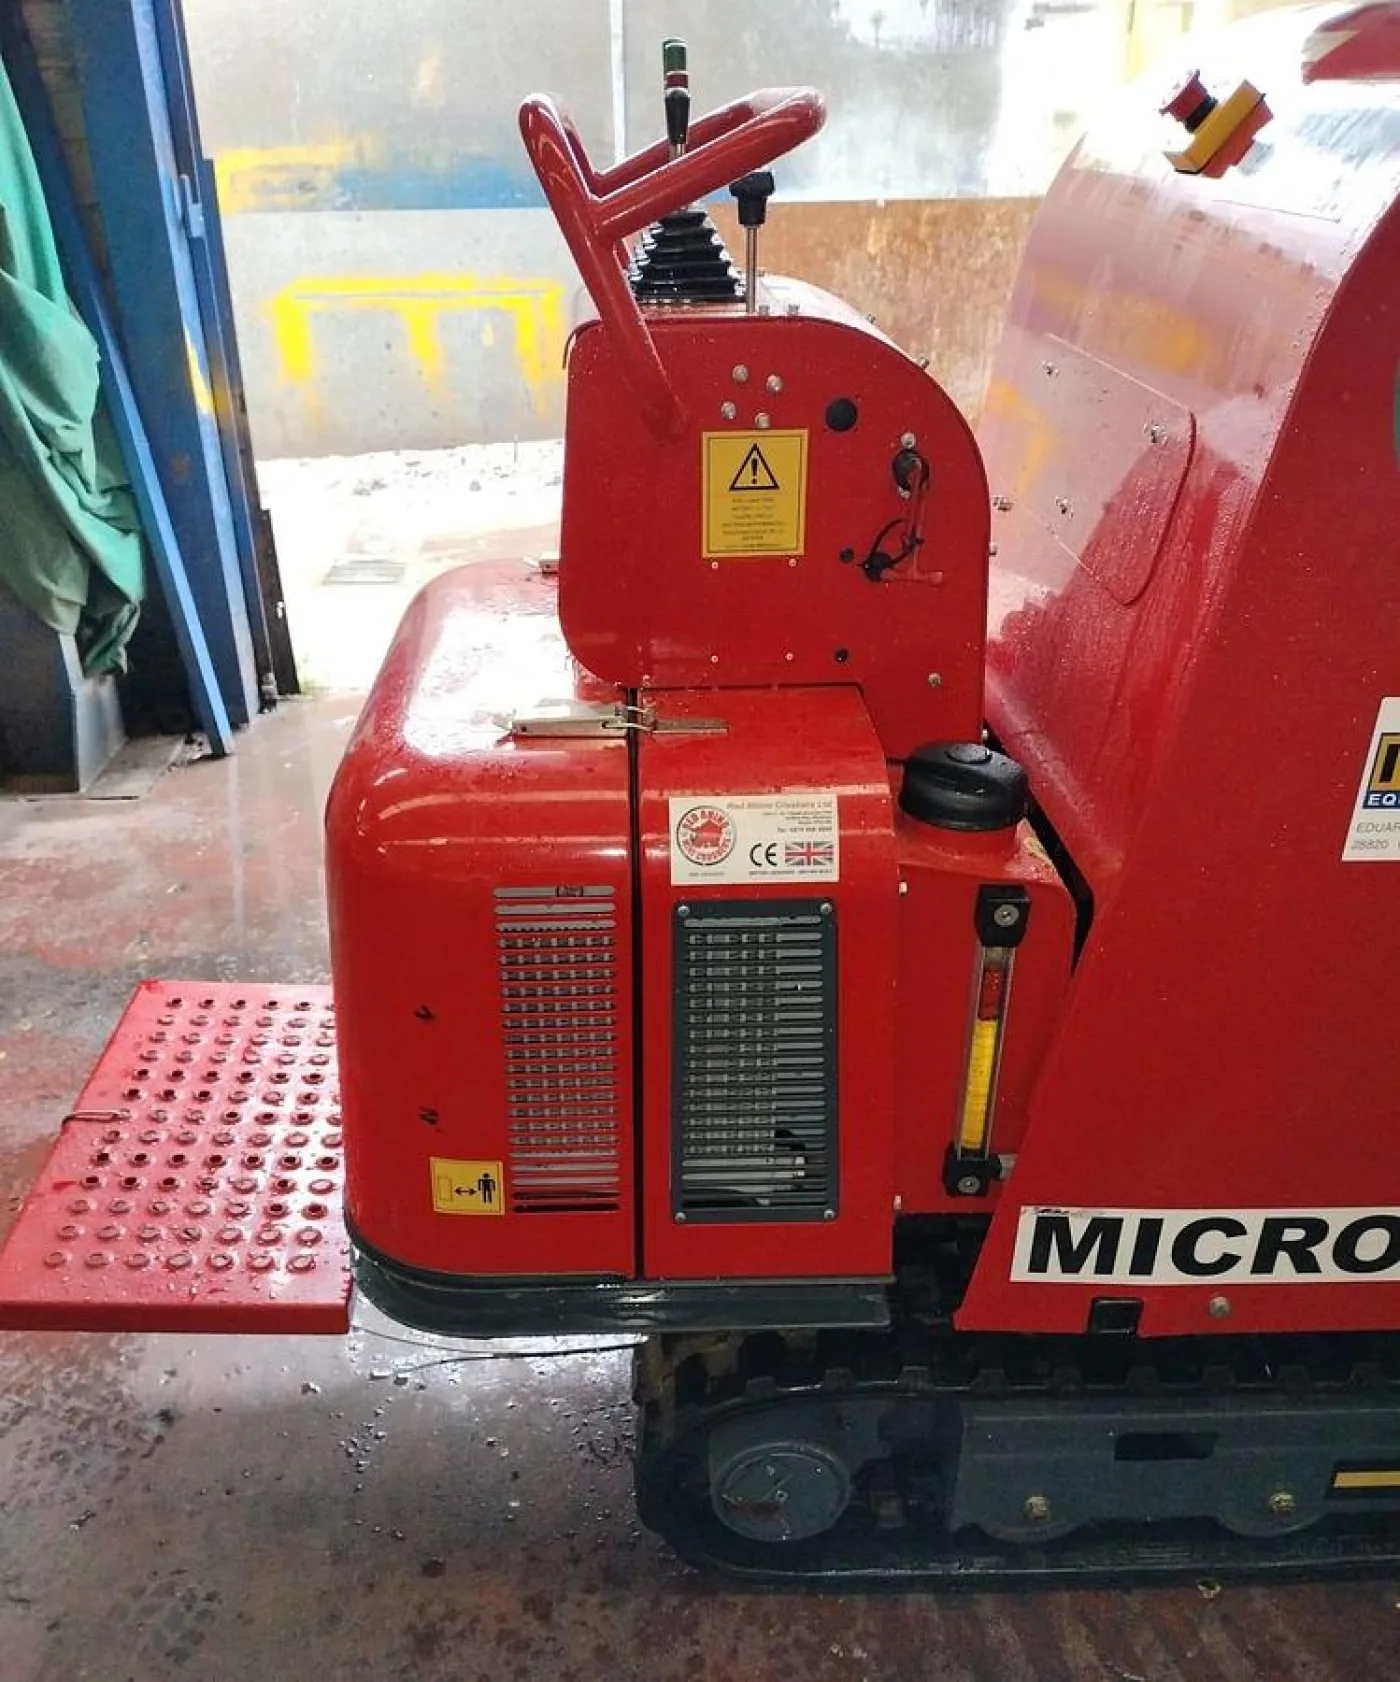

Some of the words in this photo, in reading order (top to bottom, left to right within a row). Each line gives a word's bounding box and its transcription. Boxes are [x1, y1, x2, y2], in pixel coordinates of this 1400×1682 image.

[1367, 793, 1400, 806] EQ
[749, 842, 778, 867] CE
[1027, 1214, 1400, 1277] MICRO
